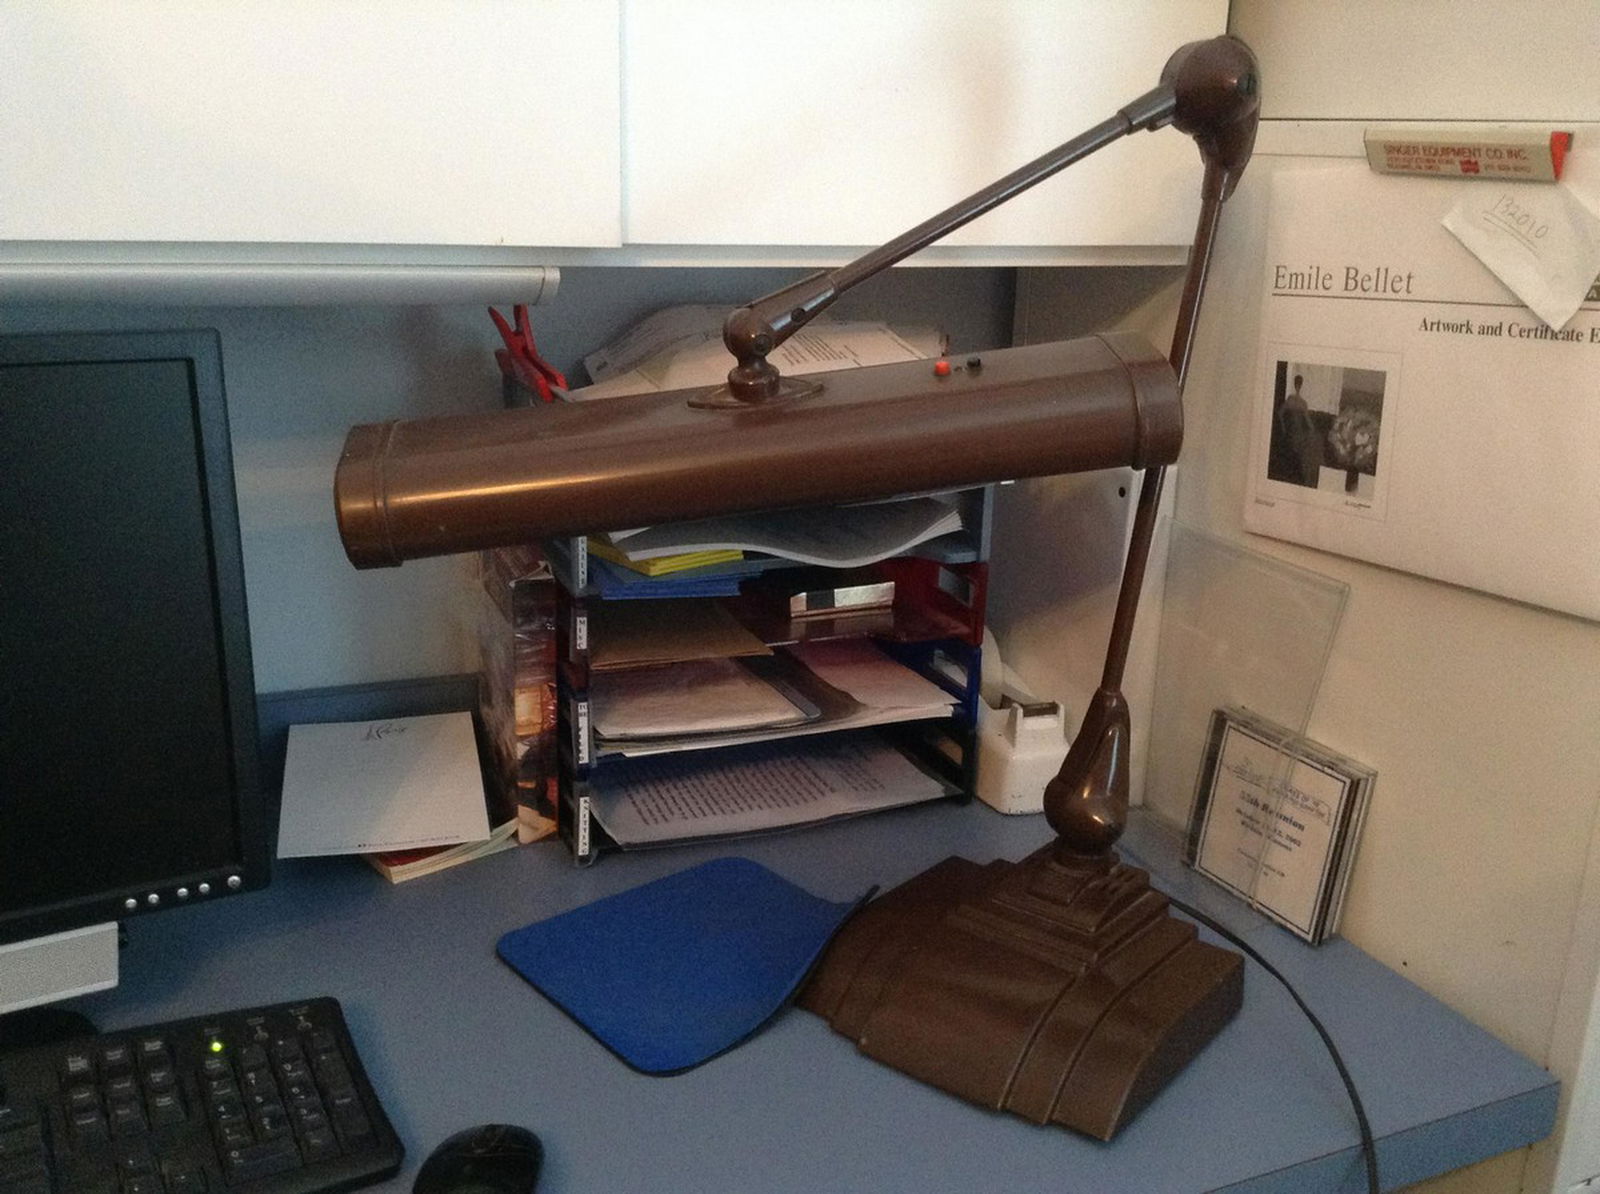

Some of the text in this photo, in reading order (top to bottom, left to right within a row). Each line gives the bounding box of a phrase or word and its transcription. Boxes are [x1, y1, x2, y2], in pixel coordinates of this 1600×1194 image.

[1421, 145, 1483, 159] EQUIPMENT
[1273, 265, 1415, 294] Emile Bellet
[1418, 317, 1475, 336] Artwork
[1477, 321, 1503, 337] and
[1507, 323, 1584, 342] Certificate
